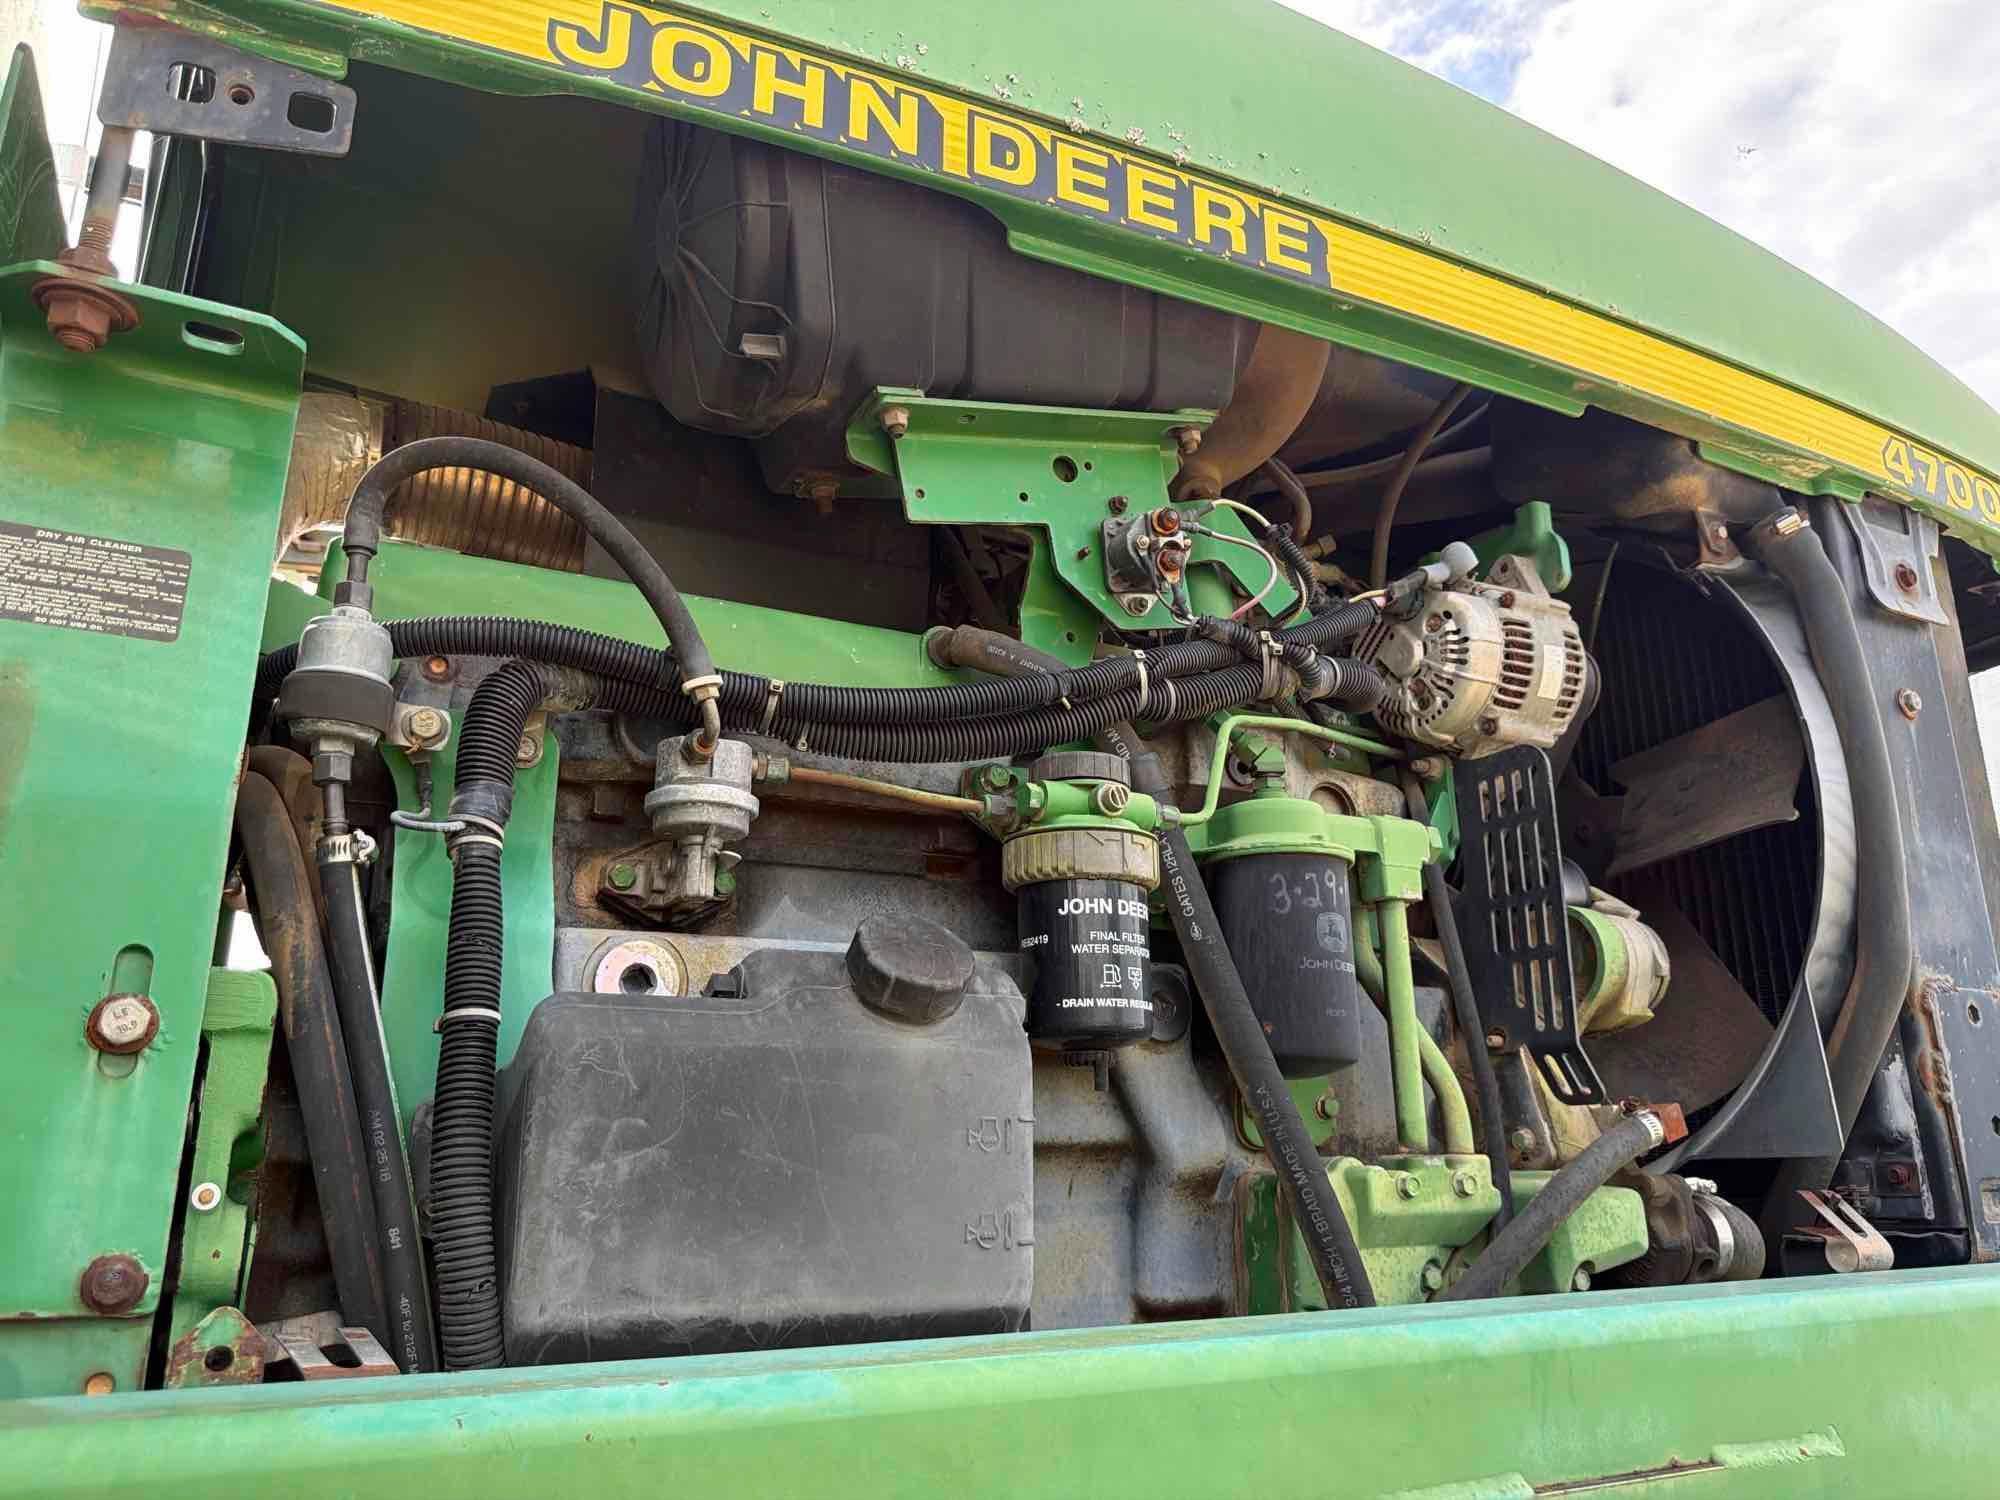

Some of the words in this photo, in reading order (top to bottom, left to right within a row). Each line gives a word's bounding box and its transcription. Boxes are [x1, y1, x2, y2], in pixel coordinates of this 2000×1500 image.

[555, 8, 919, 156] JOHN
[973, 114, 1313, 276] DEERE
[1884, 440, 2000, 524] 4700
[36, 530, 61, 541] DRY
[65, 535, 85, 545] AIR
[90, 538, 142, 553] CLEANER
[34, 616, 48, 624] DO
[50, 617, 68, 626] NOT
[70, 620, 87, 629] USE
[89, 623, 104, 631] OIL
[1058, 898, 1113, 916] JOHN
[1171, 875, 1195, 917] GATES
[1090, 930, 1120, 942] FINAL
[1122, 931, 1146, 944] FILTER
[1071, 943, 1109, 954] WATER
[1299, 956, 1334, 969] JOHN
[1062, 998, 1094, 1009] DRAIN
[1096, 998, 1128, 1009] WATER
[1272, 1121, 1289, 1143] IN
[1280, 1143, 1310, 1186] MADE
[1326, 1248, 1350, 1280] INCH
